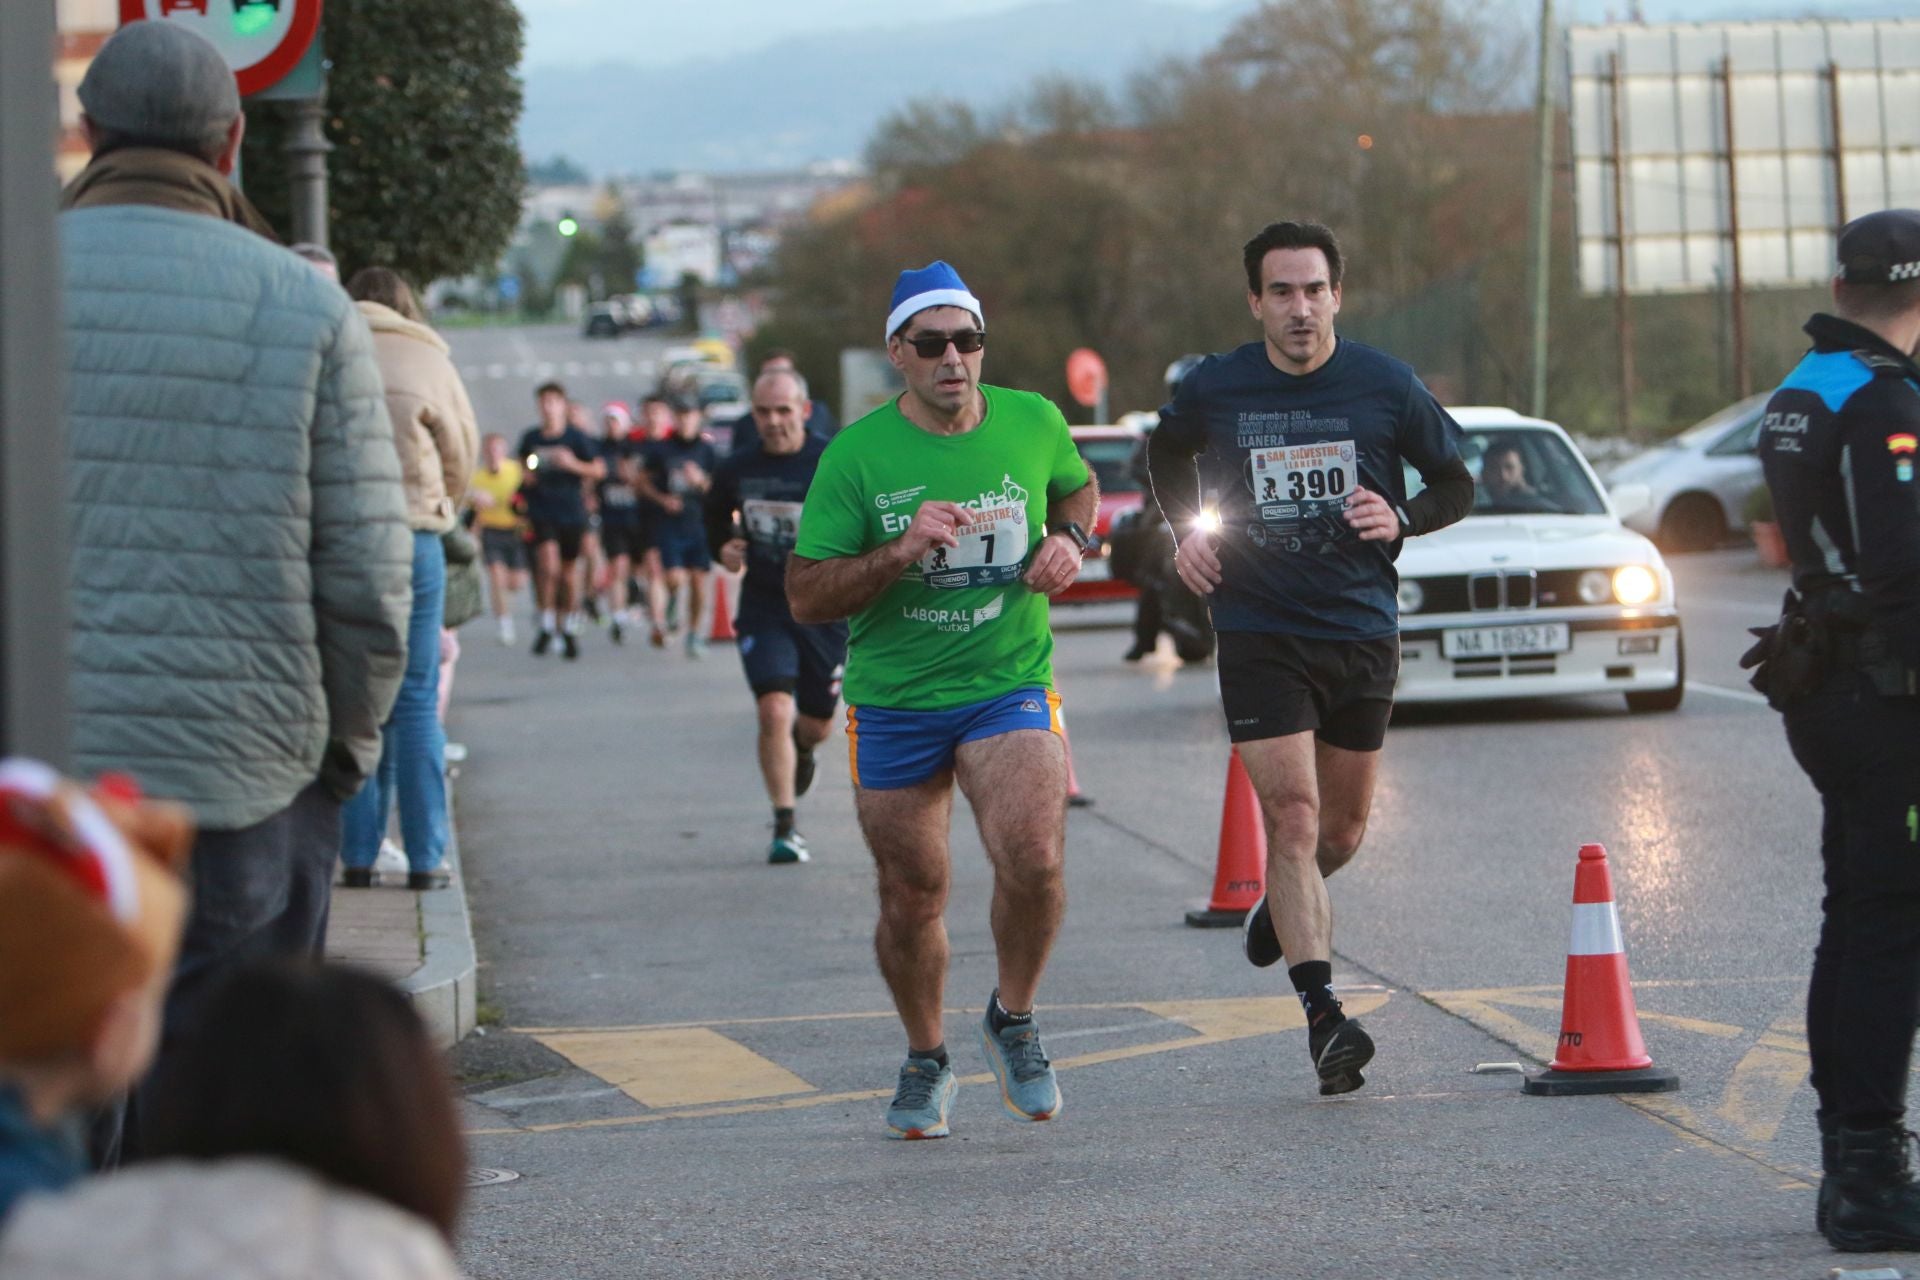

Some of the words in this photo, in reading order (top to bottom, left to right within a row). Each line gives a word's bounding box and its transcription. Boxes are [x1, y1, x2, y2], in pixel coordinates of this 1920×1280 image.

[1239, 412, 1246, 422] 31
[1248, 411, 1289, 421] diciembre
[1290, 409, 1312, 420] 2024
[1237, 434, 1286, 448] LLANERA
[1266, 450, 1286, 463] SAN
[1290, 445, 1340, 460] SILVESTRE
[1284, 458, 1324, 470] LLANERA
[1287, 467, 1345, 501] 390
[980, 534, 995, 564] 7
[903, 606, 971, 623] LABORAL
[937, 622, 970, 632] kutxa
[1456, 632, 1482, 651] NA
[1227, 880, 1261, 892] AYTO
